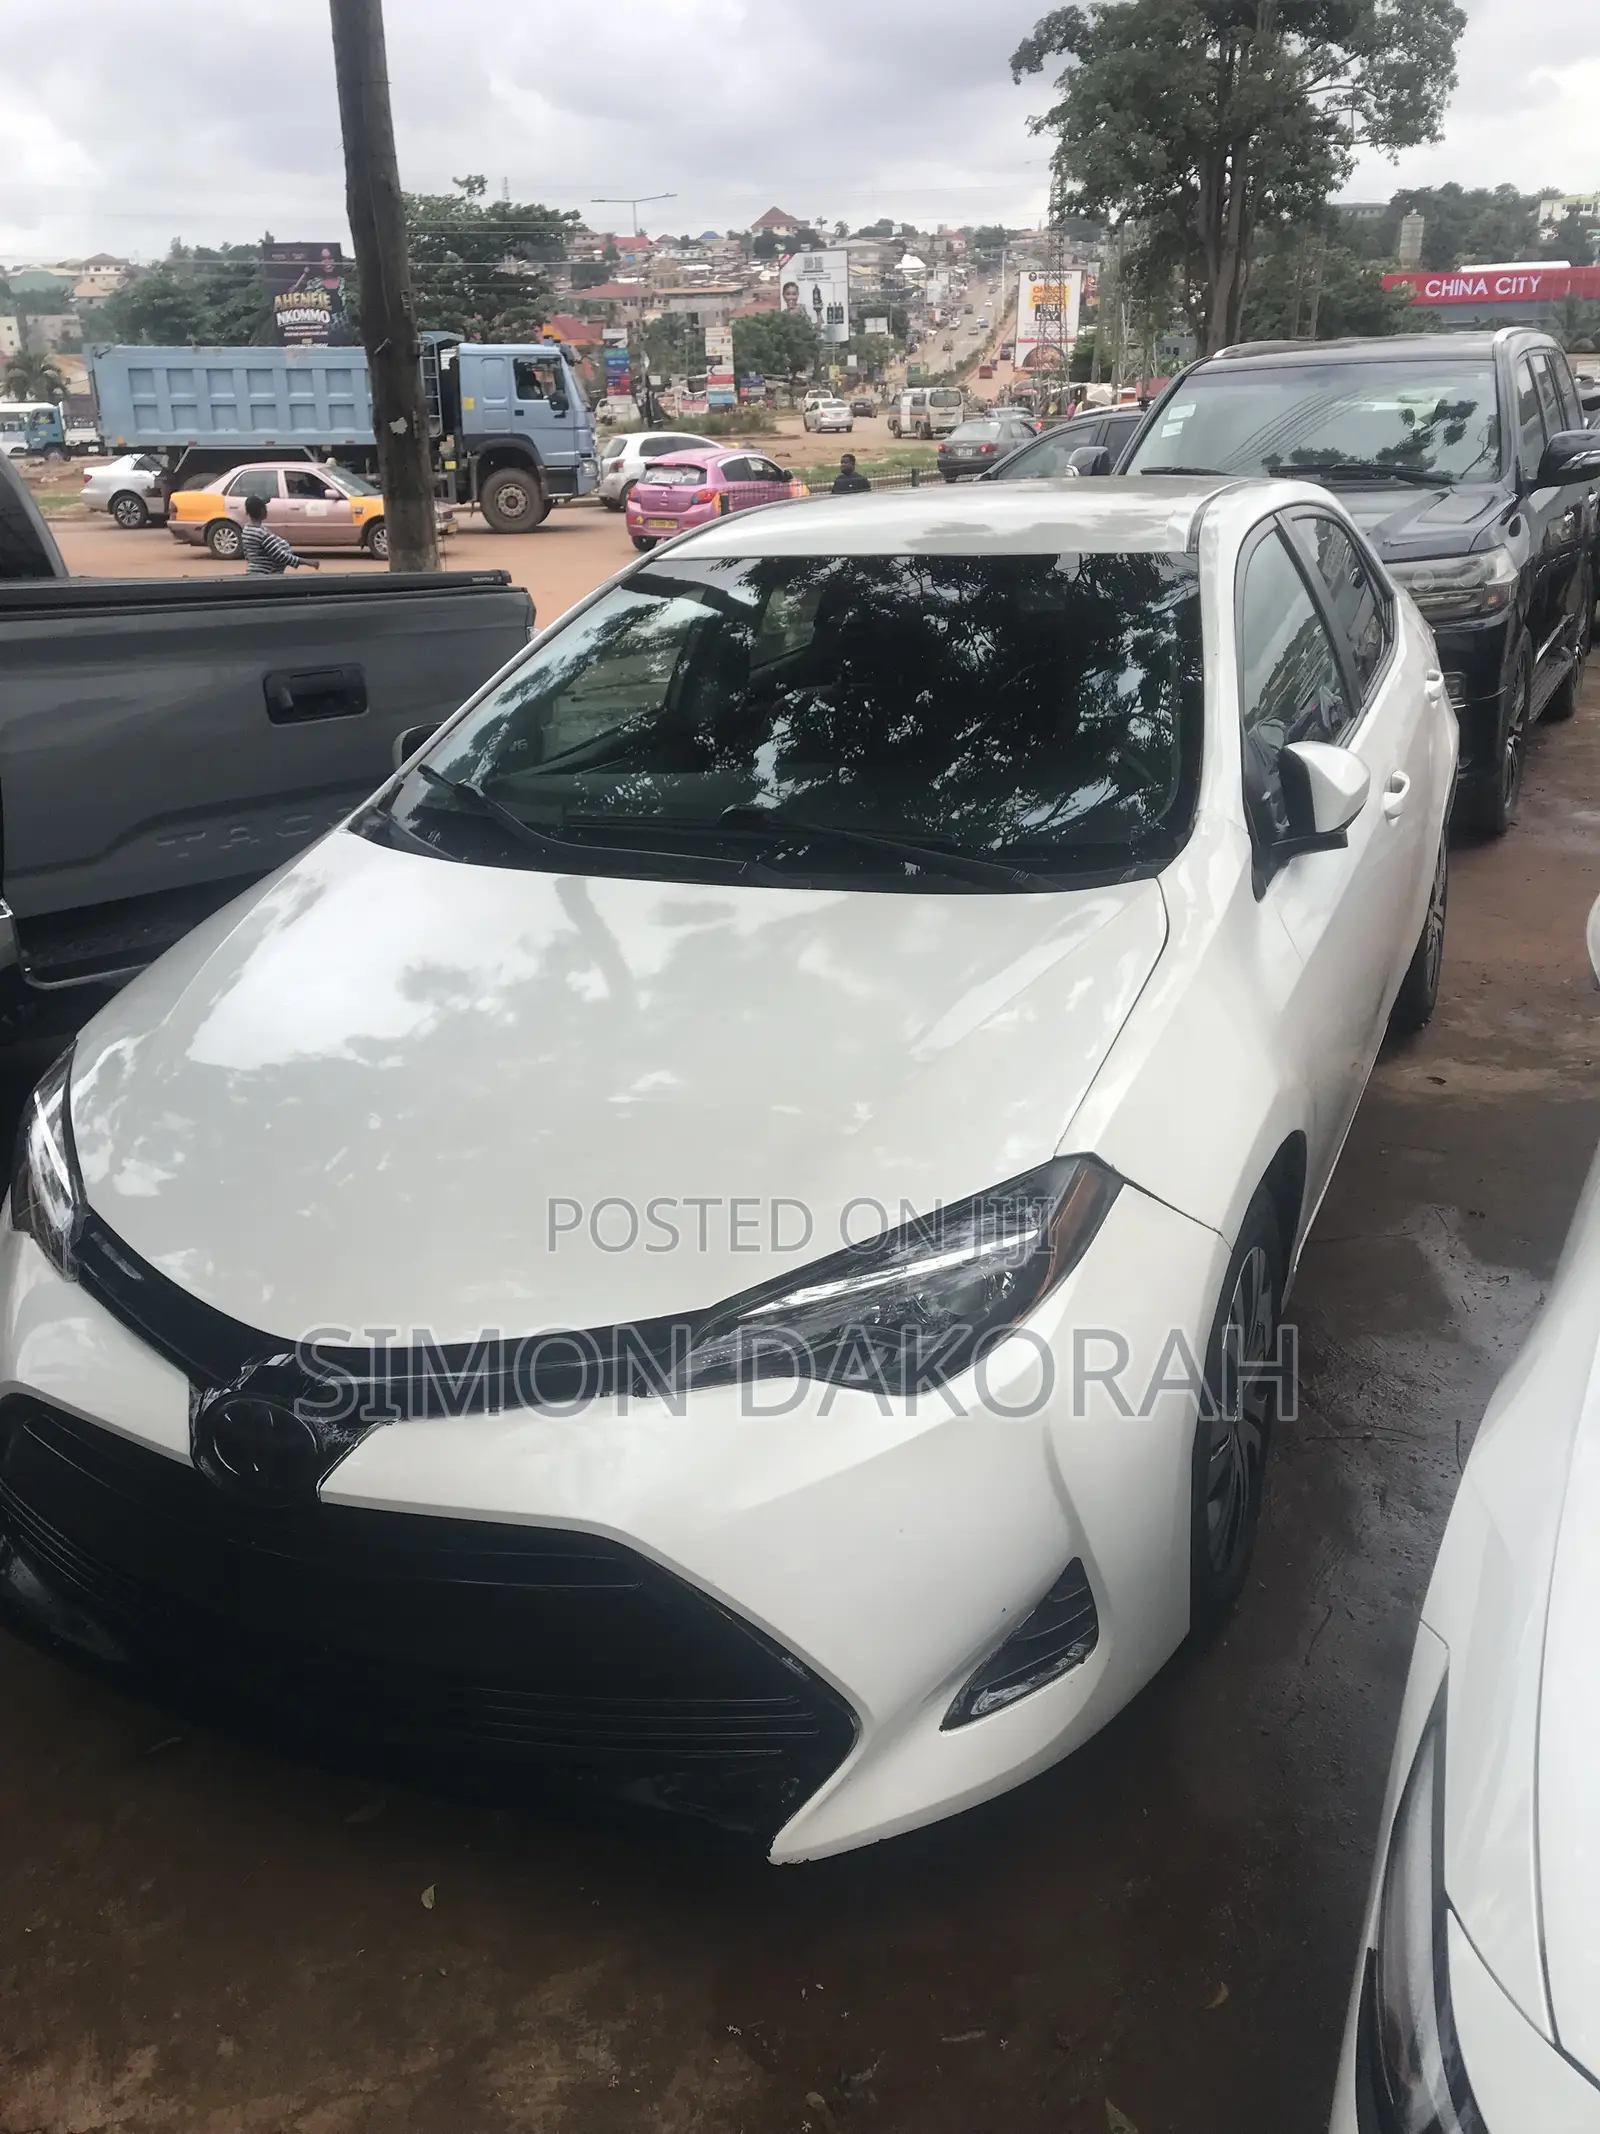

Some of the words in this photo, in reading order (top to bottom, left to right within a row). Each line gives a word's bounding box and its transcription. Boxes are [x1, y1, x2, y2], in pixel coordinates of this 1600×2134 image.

[1425, 277, 1488, 297] CHINA
[1495, 275, 1541, 295] CITY
[277, 309, 331, 325] NKOMMO
